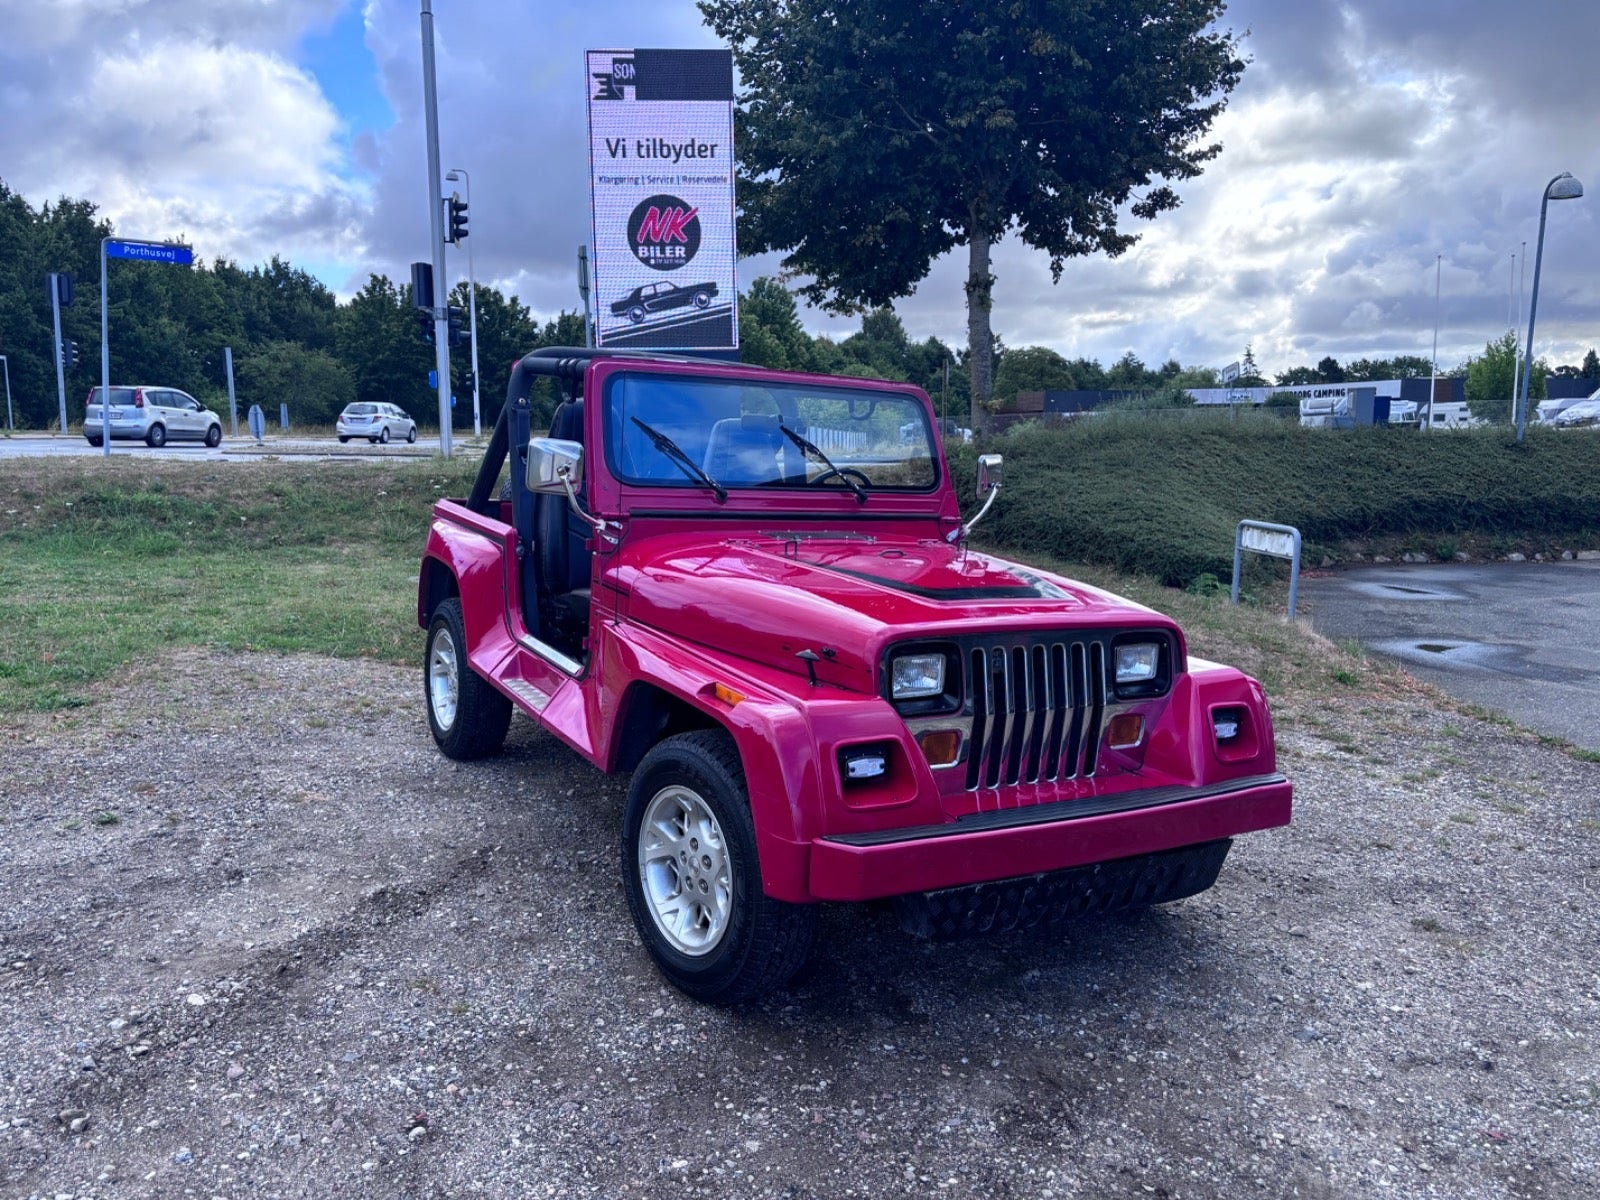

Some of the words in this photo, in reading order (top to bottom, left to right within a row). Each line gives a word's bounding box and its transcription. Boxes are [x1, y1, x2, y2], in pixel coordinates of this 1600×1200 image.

[605, 137, 627, 159] Vi
[636, 137, 719, 165] tilbyder
[647, 175, 674, 185] Service
[682, 175, 728, 184] Reservedele
[636, 205, 699, 244] NK
[123, 246, 176, 260] Porthusvej
[638, 245, 687, 258] BILER
[1313, 387, 1346, 398] CAMPING
